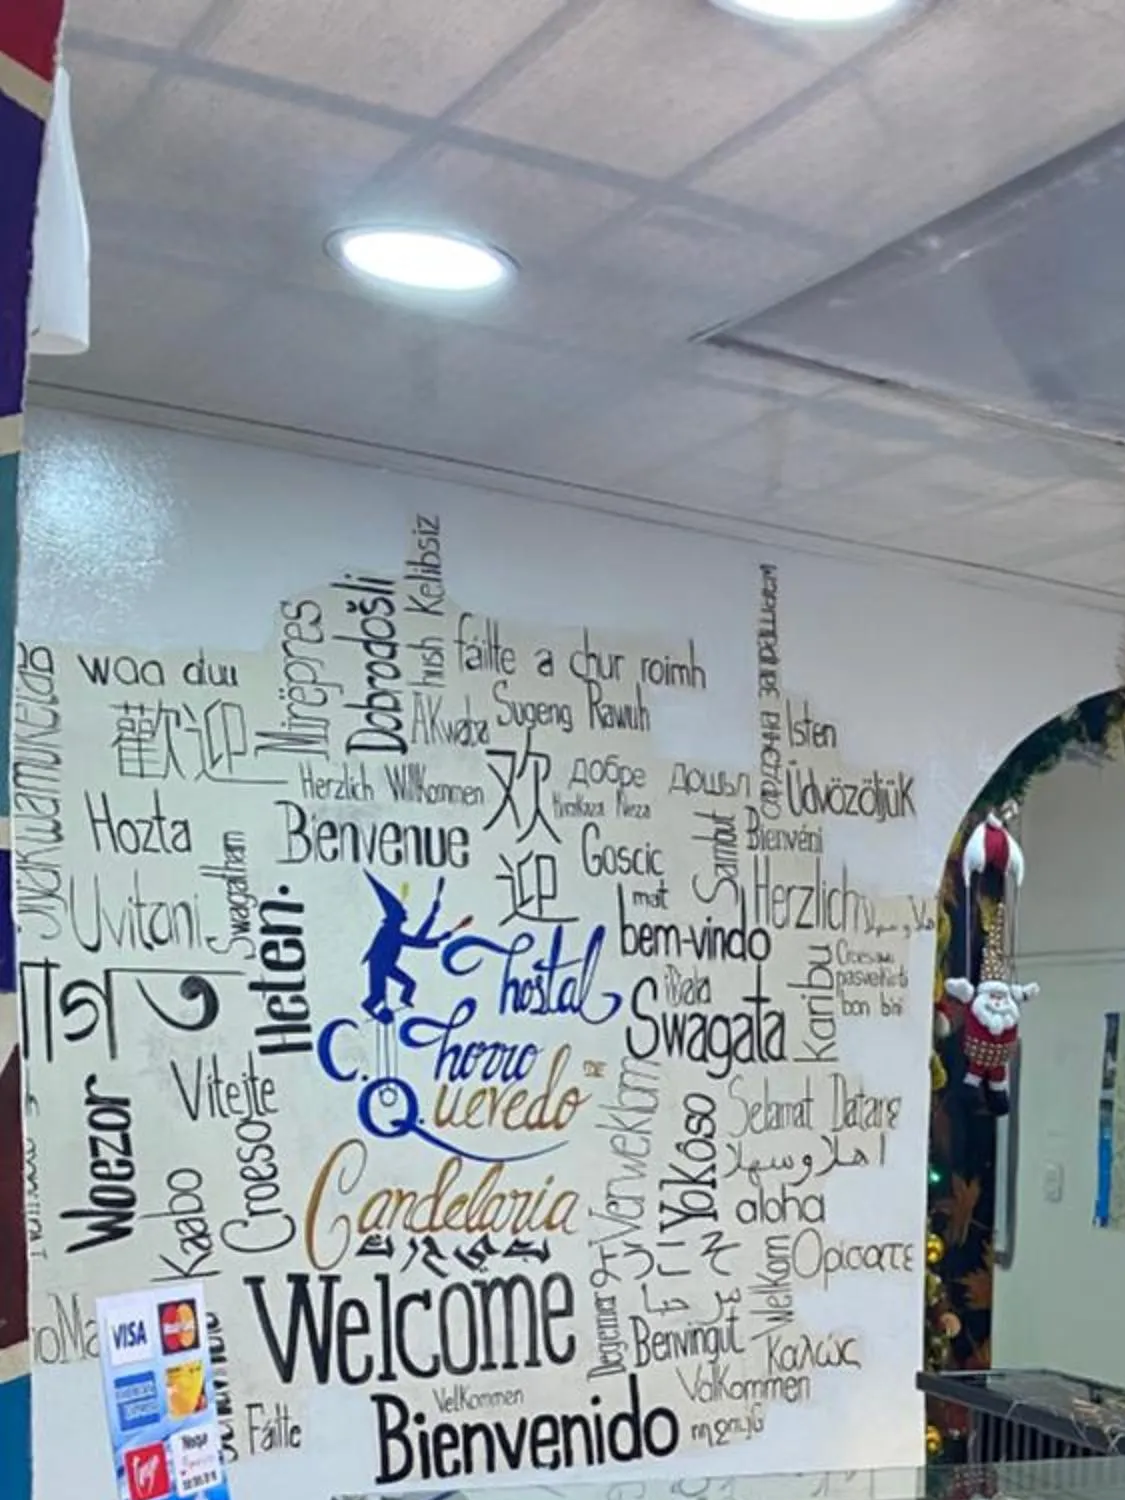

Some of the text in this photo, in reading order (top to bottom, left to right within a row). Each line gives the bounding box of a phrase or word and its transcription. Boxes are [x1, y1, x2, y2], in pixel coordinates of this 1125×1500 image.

[330, 573, 409, 756] Dobrodošli
[534, 647, 555, 678] a
[569, 625, 625, 683] chur
[640, 638, 707, 689] roimh
[491, 680, 575, 733] Sugeng
[785, 698, 838, 750] Isten
[273, 799, 470, 869] Bienvenue
[618, 882, 772, 962] bem-vindo
[625, 965, 788, 1080] Swagata
[169, 1049, 280, 1123] Vitejte
[727, 1072, 816, 1139] Selamat
[58, 1072, 138, 1255] Woezor
[219, 1116, 297, 1254] Croeso
[303, 1137, 583, 1272] Candelaria
[735, 1182, 828, 1226] aloha
[112, 1319, 149, 1350] VISA
[242, 1267, 579, 1388] Welcome
[369, 1372, 681, 1486] Bienvenido
